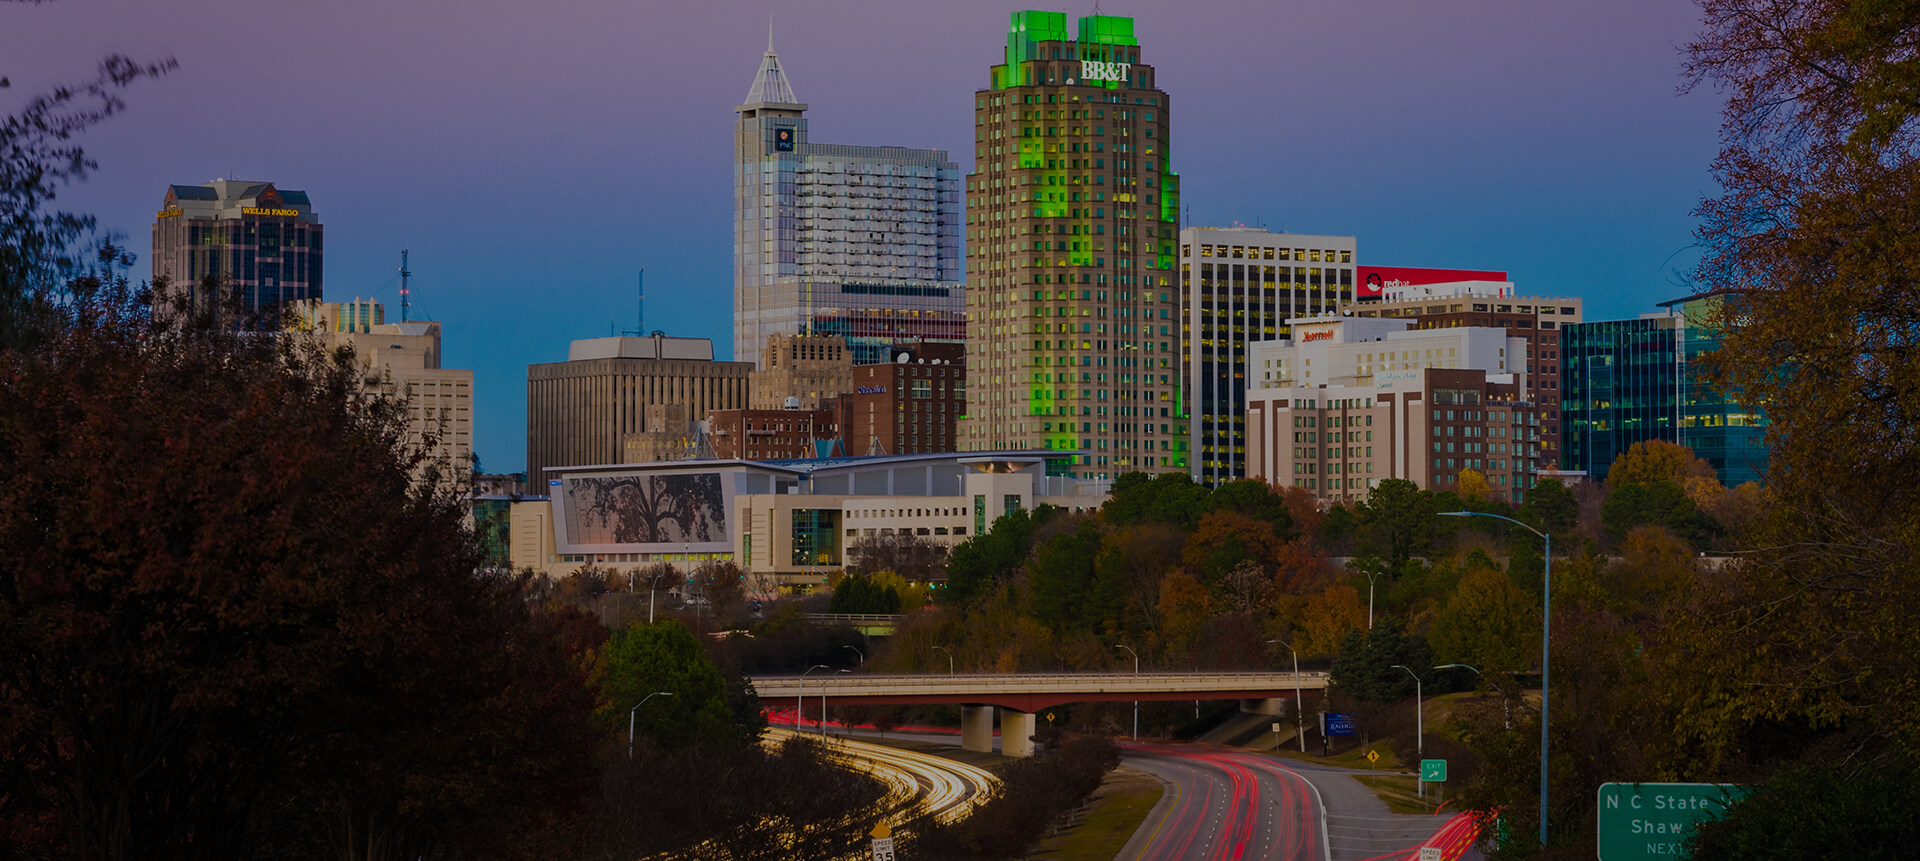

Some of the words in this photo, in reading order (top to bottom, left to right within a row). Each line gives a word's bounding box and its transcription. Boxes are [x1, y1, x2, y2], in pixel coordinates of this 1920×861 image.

[1080, 60, 1131, 82] BB&T
[242, 207, 270, 216] WELLS
[271, 208, 299, 217] FARGO
[1302, 329, 1334, 343] Marriott
[1606, 795, 1619, 809] N
[1631, 795, 1642, 809] C
[1654, 794, 1709, 810] State
[1631, 819, 1683, 834] Shaw
[876, 851, 893, 861] 35
